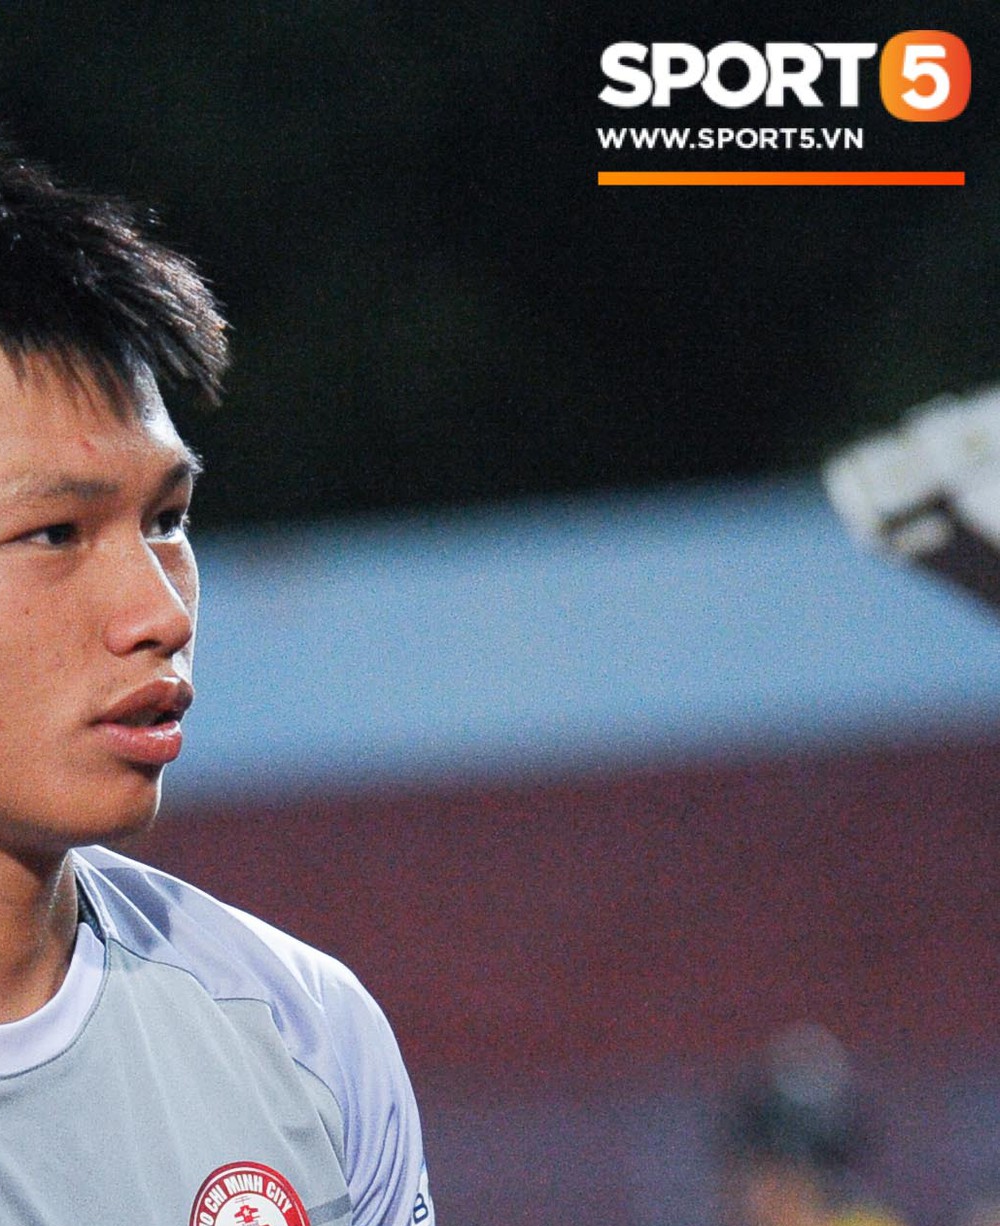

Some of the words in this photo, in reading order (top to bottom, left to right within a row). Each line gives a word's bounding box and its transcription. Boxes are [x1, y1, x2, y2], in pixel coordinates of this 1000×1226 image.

[204, 1184, 228, 1209] CHI
[223, 1173, 263, 1196] MINH
[265, 1180, 293, 1214] CITY
